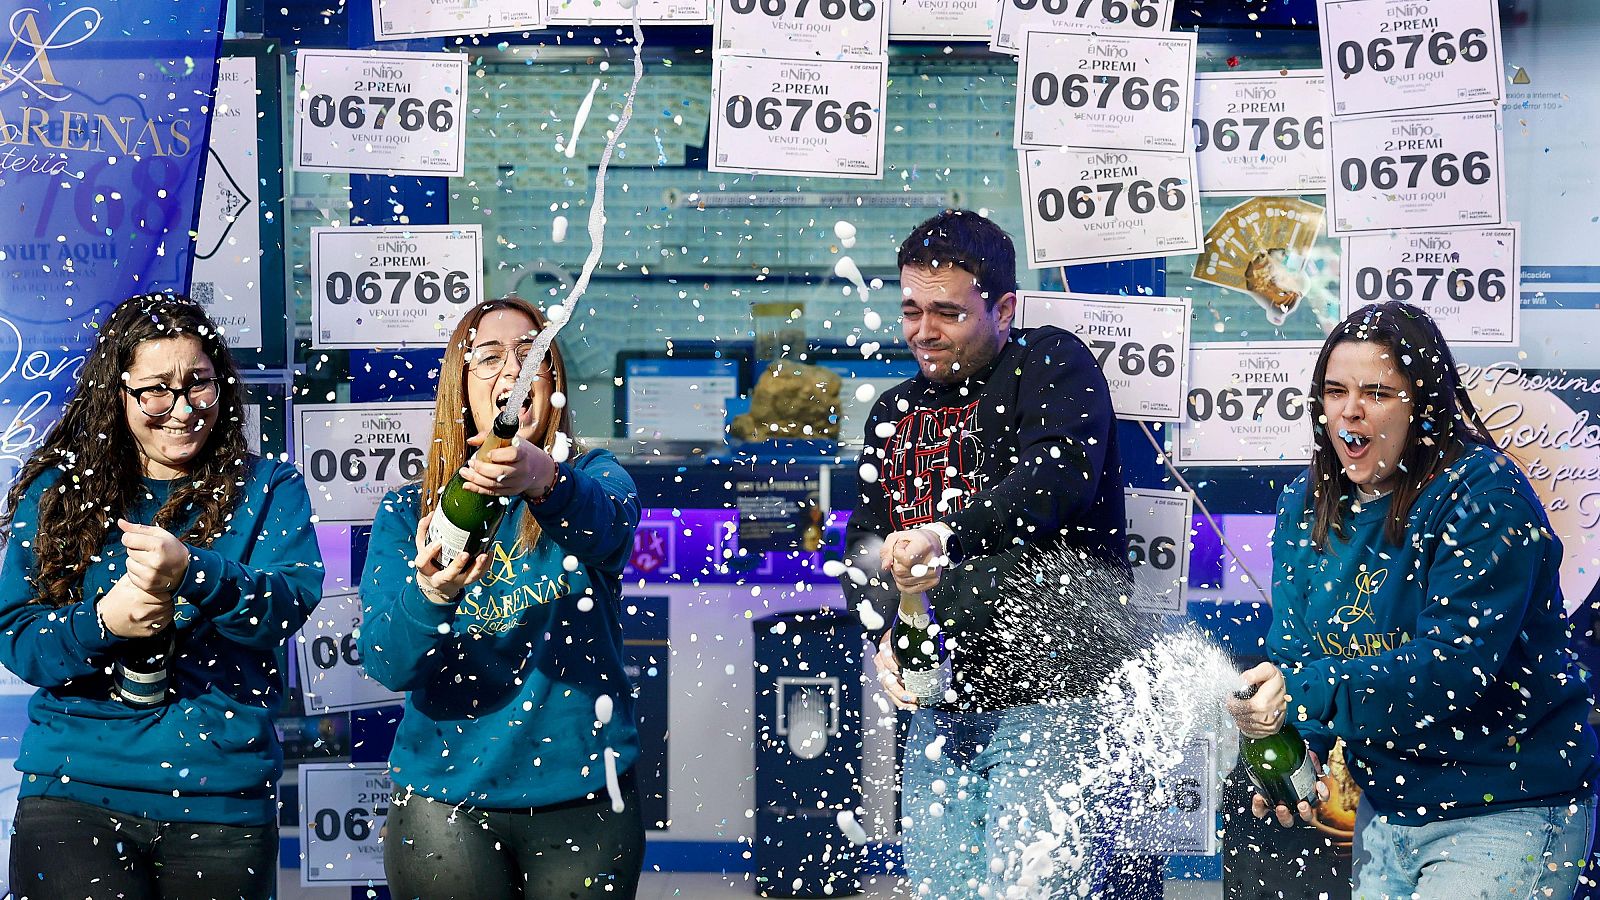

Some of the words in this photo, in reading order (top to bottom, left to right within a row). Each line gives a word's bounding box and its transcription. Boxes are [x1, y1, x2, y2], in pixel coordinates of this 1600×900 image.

[918, 0, 949, 9] VENUT
[1396, 4, 1429, 18] Niño
[772, 21, 803, 31] VENUT
[1393, 18, 1439, 32] PREMI
[1096, 44, 1129, 58] Niño
[1337, 28, 1488, 75] 06766
[371, 65, 403, 81] Niño
[1092, 61, 1136, 72] PREMI
[789, 68, 821, 81] Niño
[1383, 73, 1415, 85] VENUT
[367, 81, 411, 93] PREMI
[785, 83, 829, 95] PREMI
[1031, 72, 1180, 112] 06766
[1244, 87, 1276, 100] Niño
[1241, 102, 1285, 113] PREMI
[1522, 102, 1541, 110] rror
[309, 94, 454, 133] 06766
[725, 94, 872, 135] 06766
[1192, 116, 1324, 152] 06766
[1400, 123, 1433, 137] Niño
[352, 133, 383, 143] VENUT
[768, 135, 800, 144] VENUT
[1398, 138, 1443, 150] PREMI
[1226, 156, 1258, 164] VENUT
[1094, 166, 1138, 179] PREMI
[1340, 151, 1491, 192] 06766
[1038, 177, 1186, 222] 06766
[1083, 220, 1116, 231] VENUT
[386, 240, 418, 254] Niño
[1419, 237, 1451, 250] Niño
[383, 256, 426, 267] PREMI
[326, 271, 471, 305] 06766
[1355, 266, 1506, 302] 06766
[369, 308, 401, 317] VENUT
[1091, 310, 1123, 324] Niño
[1088, 325, 1132, 337] PREMI
[1247, 357, 1280, 370] Niño
[1245, 373, 1289, 383] PREMI
[370, 418, 401, 431] Niño
[367, 433, 411, 444] PREMI
[354, 485, 385, 494] VENUT
[479, 574, 571, 618] ARENAS
